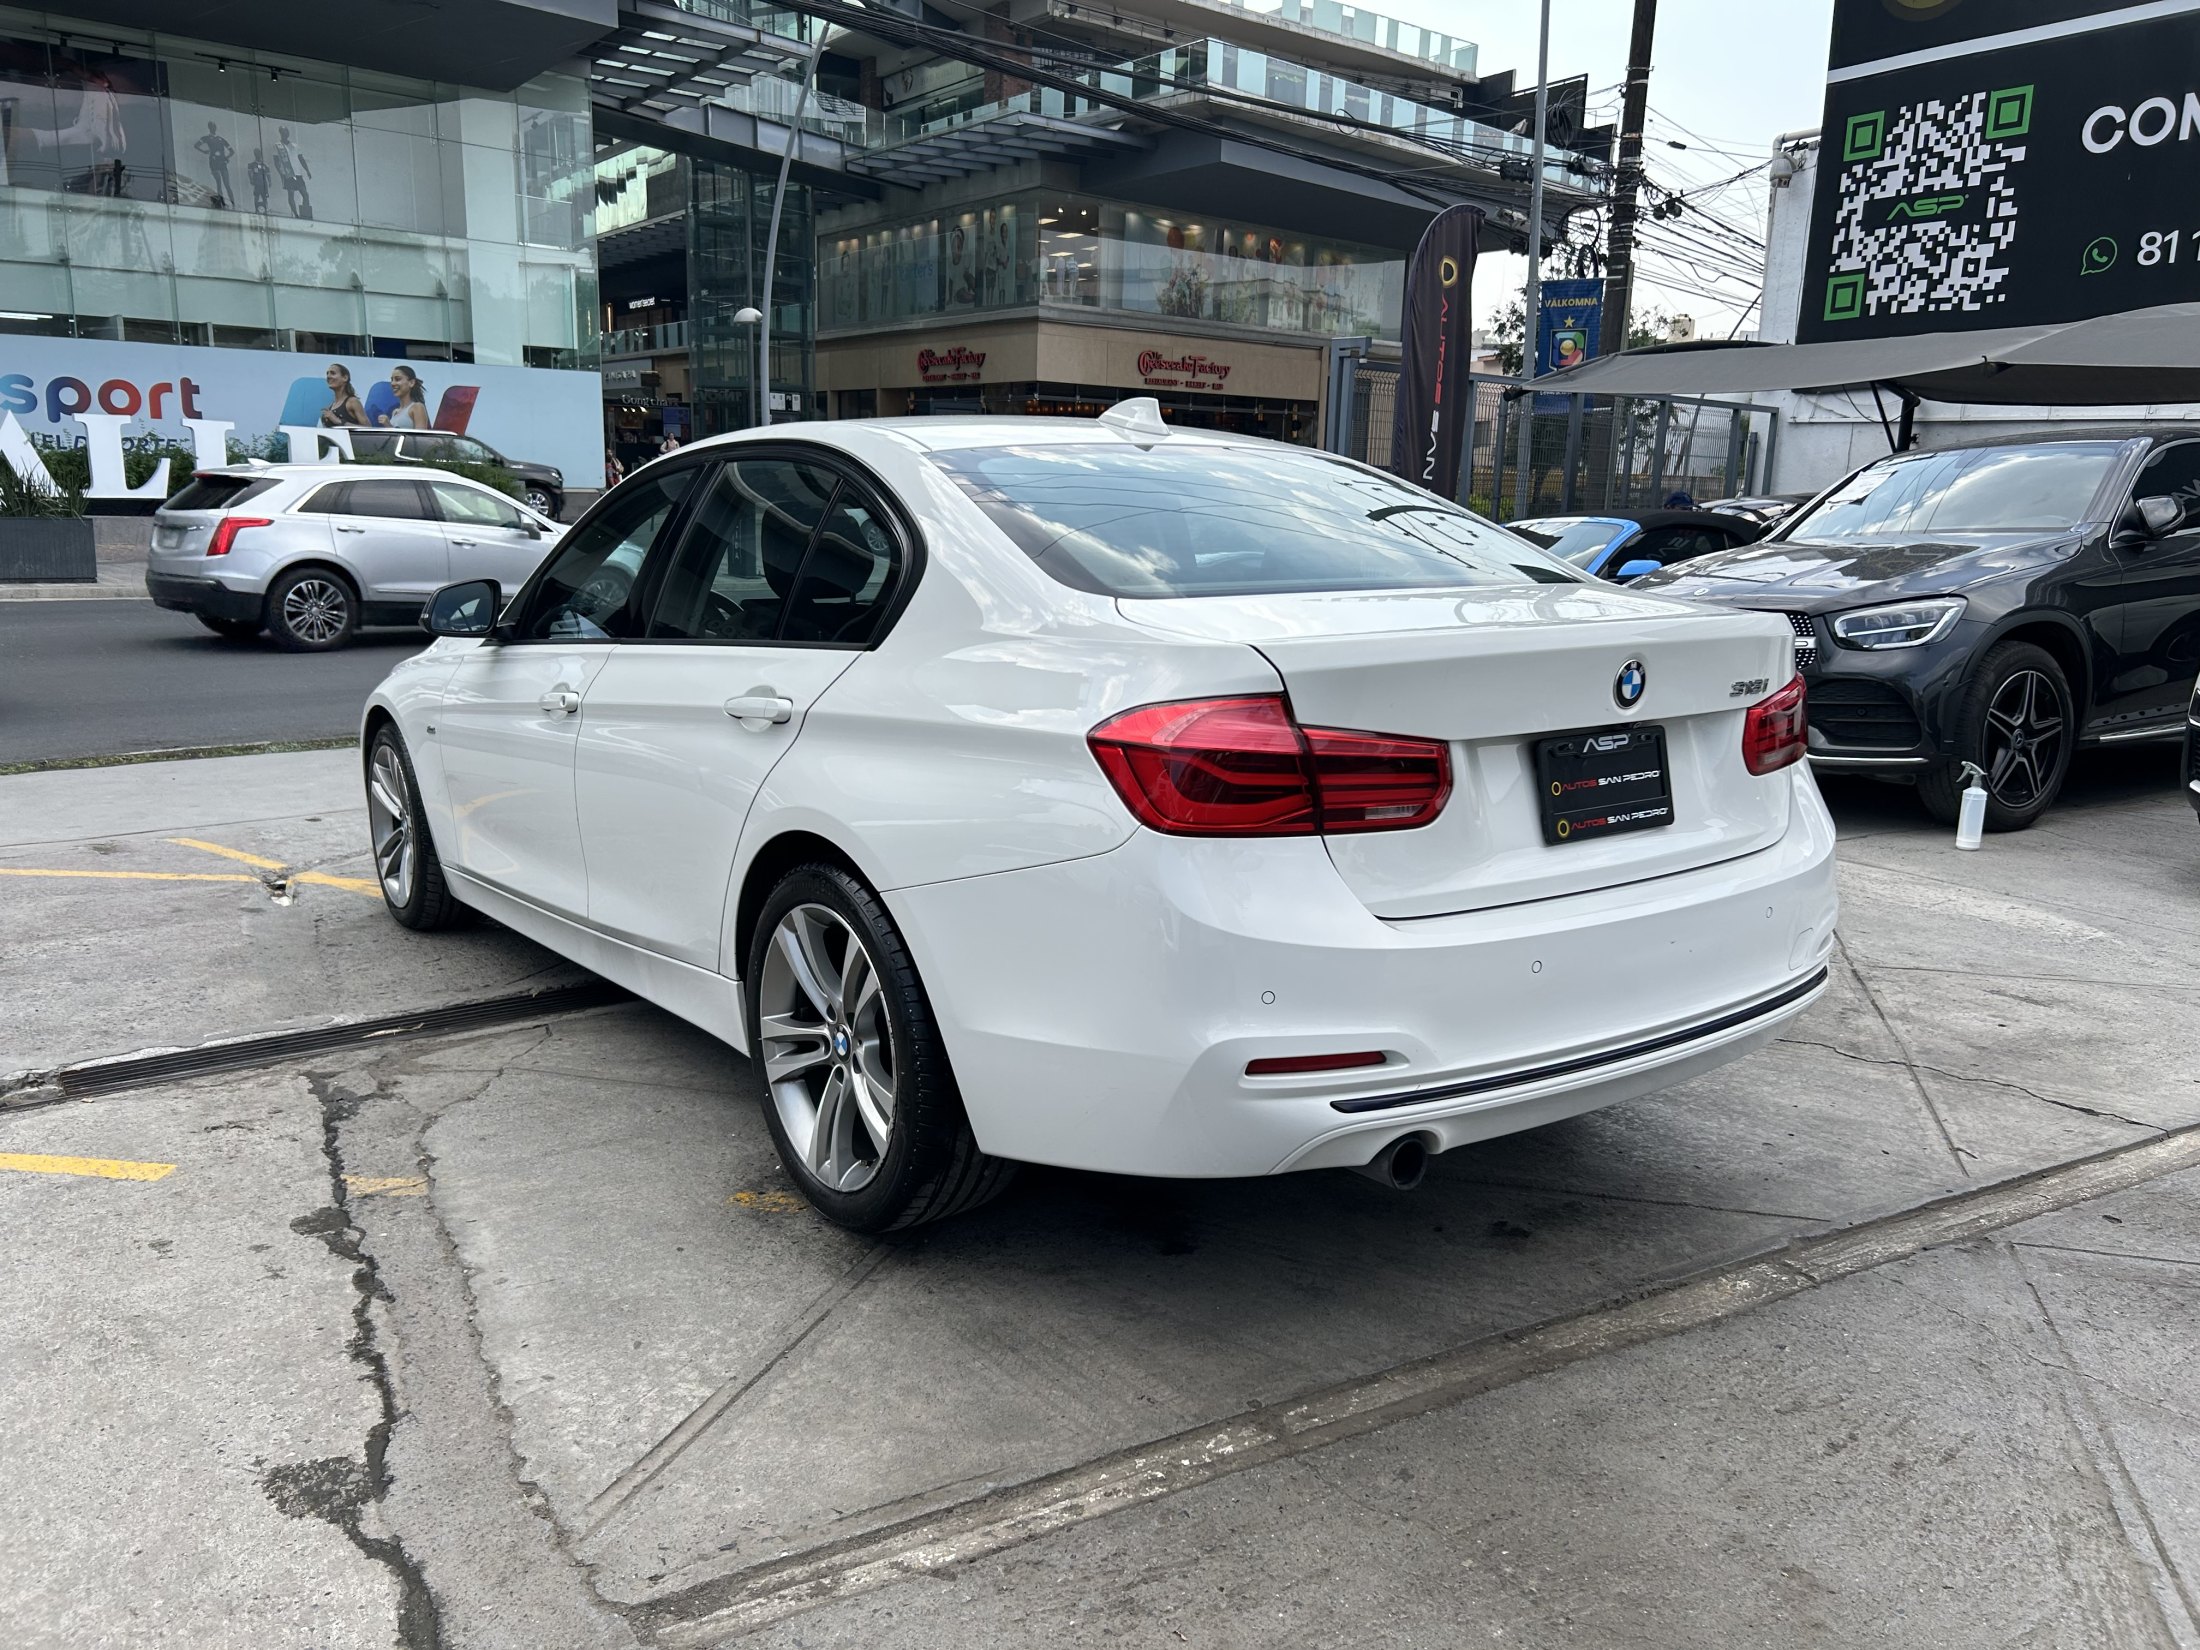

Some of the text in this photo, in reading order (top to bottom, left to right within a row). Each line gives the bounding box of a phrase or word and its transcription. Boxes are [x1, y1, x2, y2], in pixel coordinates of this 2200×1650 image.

[1887, 195, 1965, 220] ASP
[2137, 230, 2179, 266] 81
[1138, 350, 1231, 380] Cheesecake Factory
[0, 374, 202, 423] sport
[1583, 734, 1629, 753] ASP
[1562, 769, 1661, 792] AUTOS SAN PEDRO
[1571, 807, 1668, 831] AUTOS SAN PEDRO
